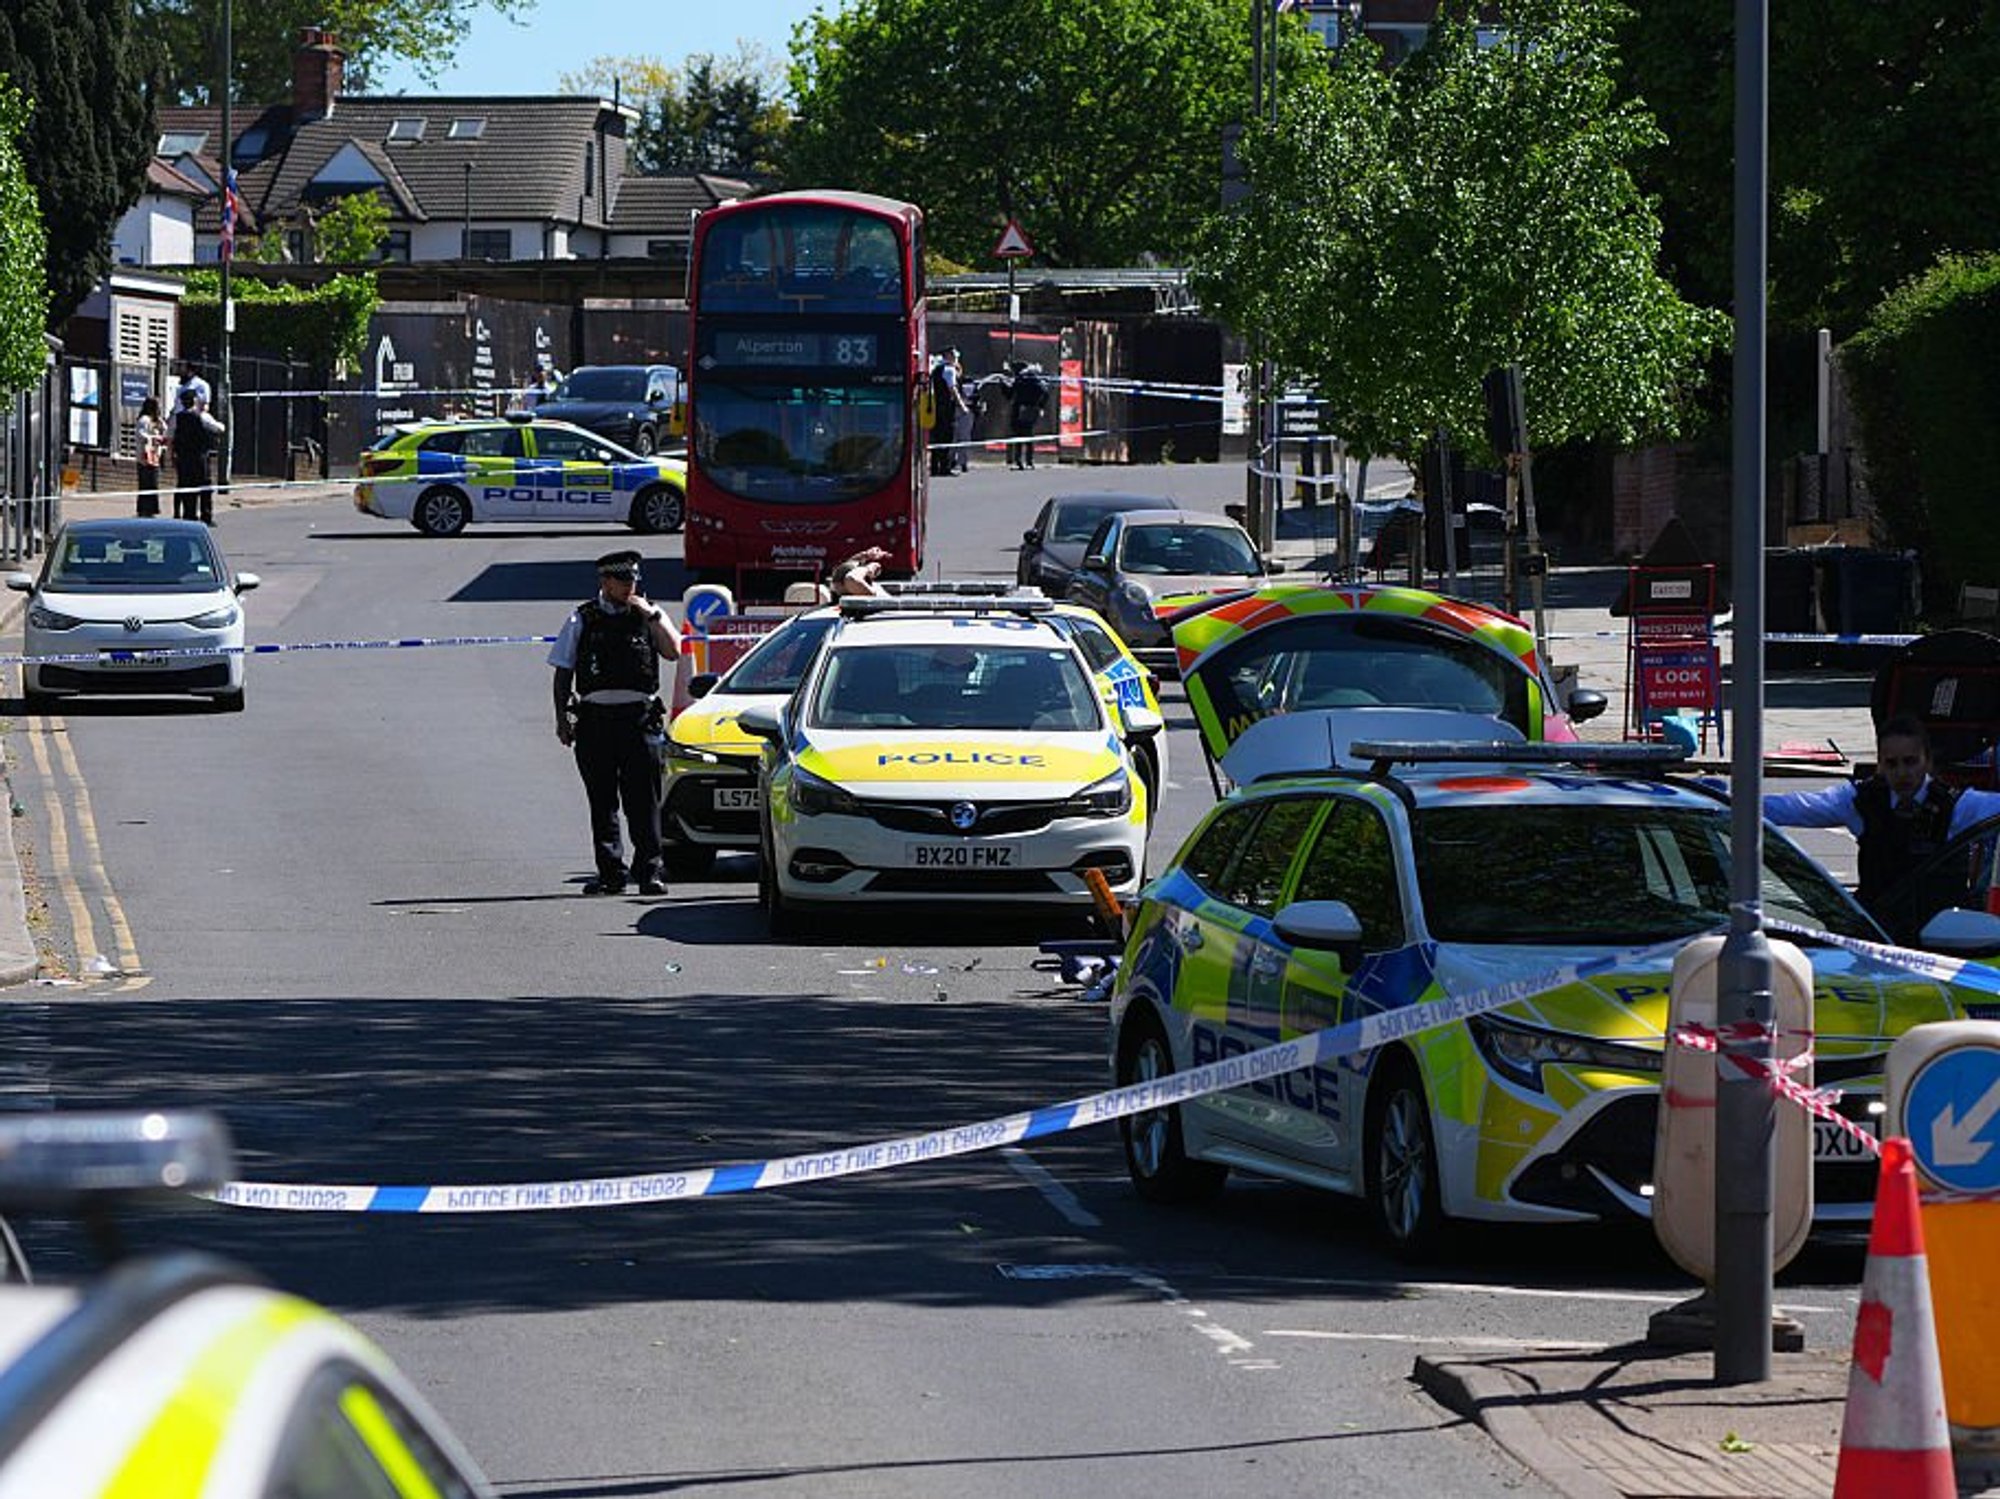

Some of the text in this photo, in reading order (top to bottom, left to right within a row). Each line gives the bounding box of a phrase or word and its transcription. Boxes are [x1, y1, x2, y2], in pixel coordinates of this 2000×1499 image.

[736, 338, 869, 364] Alperton 83
[483, 487, 612, 504] POLICE
[1655, 670, 1702, 684] LOOK
[877, 752, 1047, 768] POLICE
[916, 846, 1012, 867] BX20 FMZ
